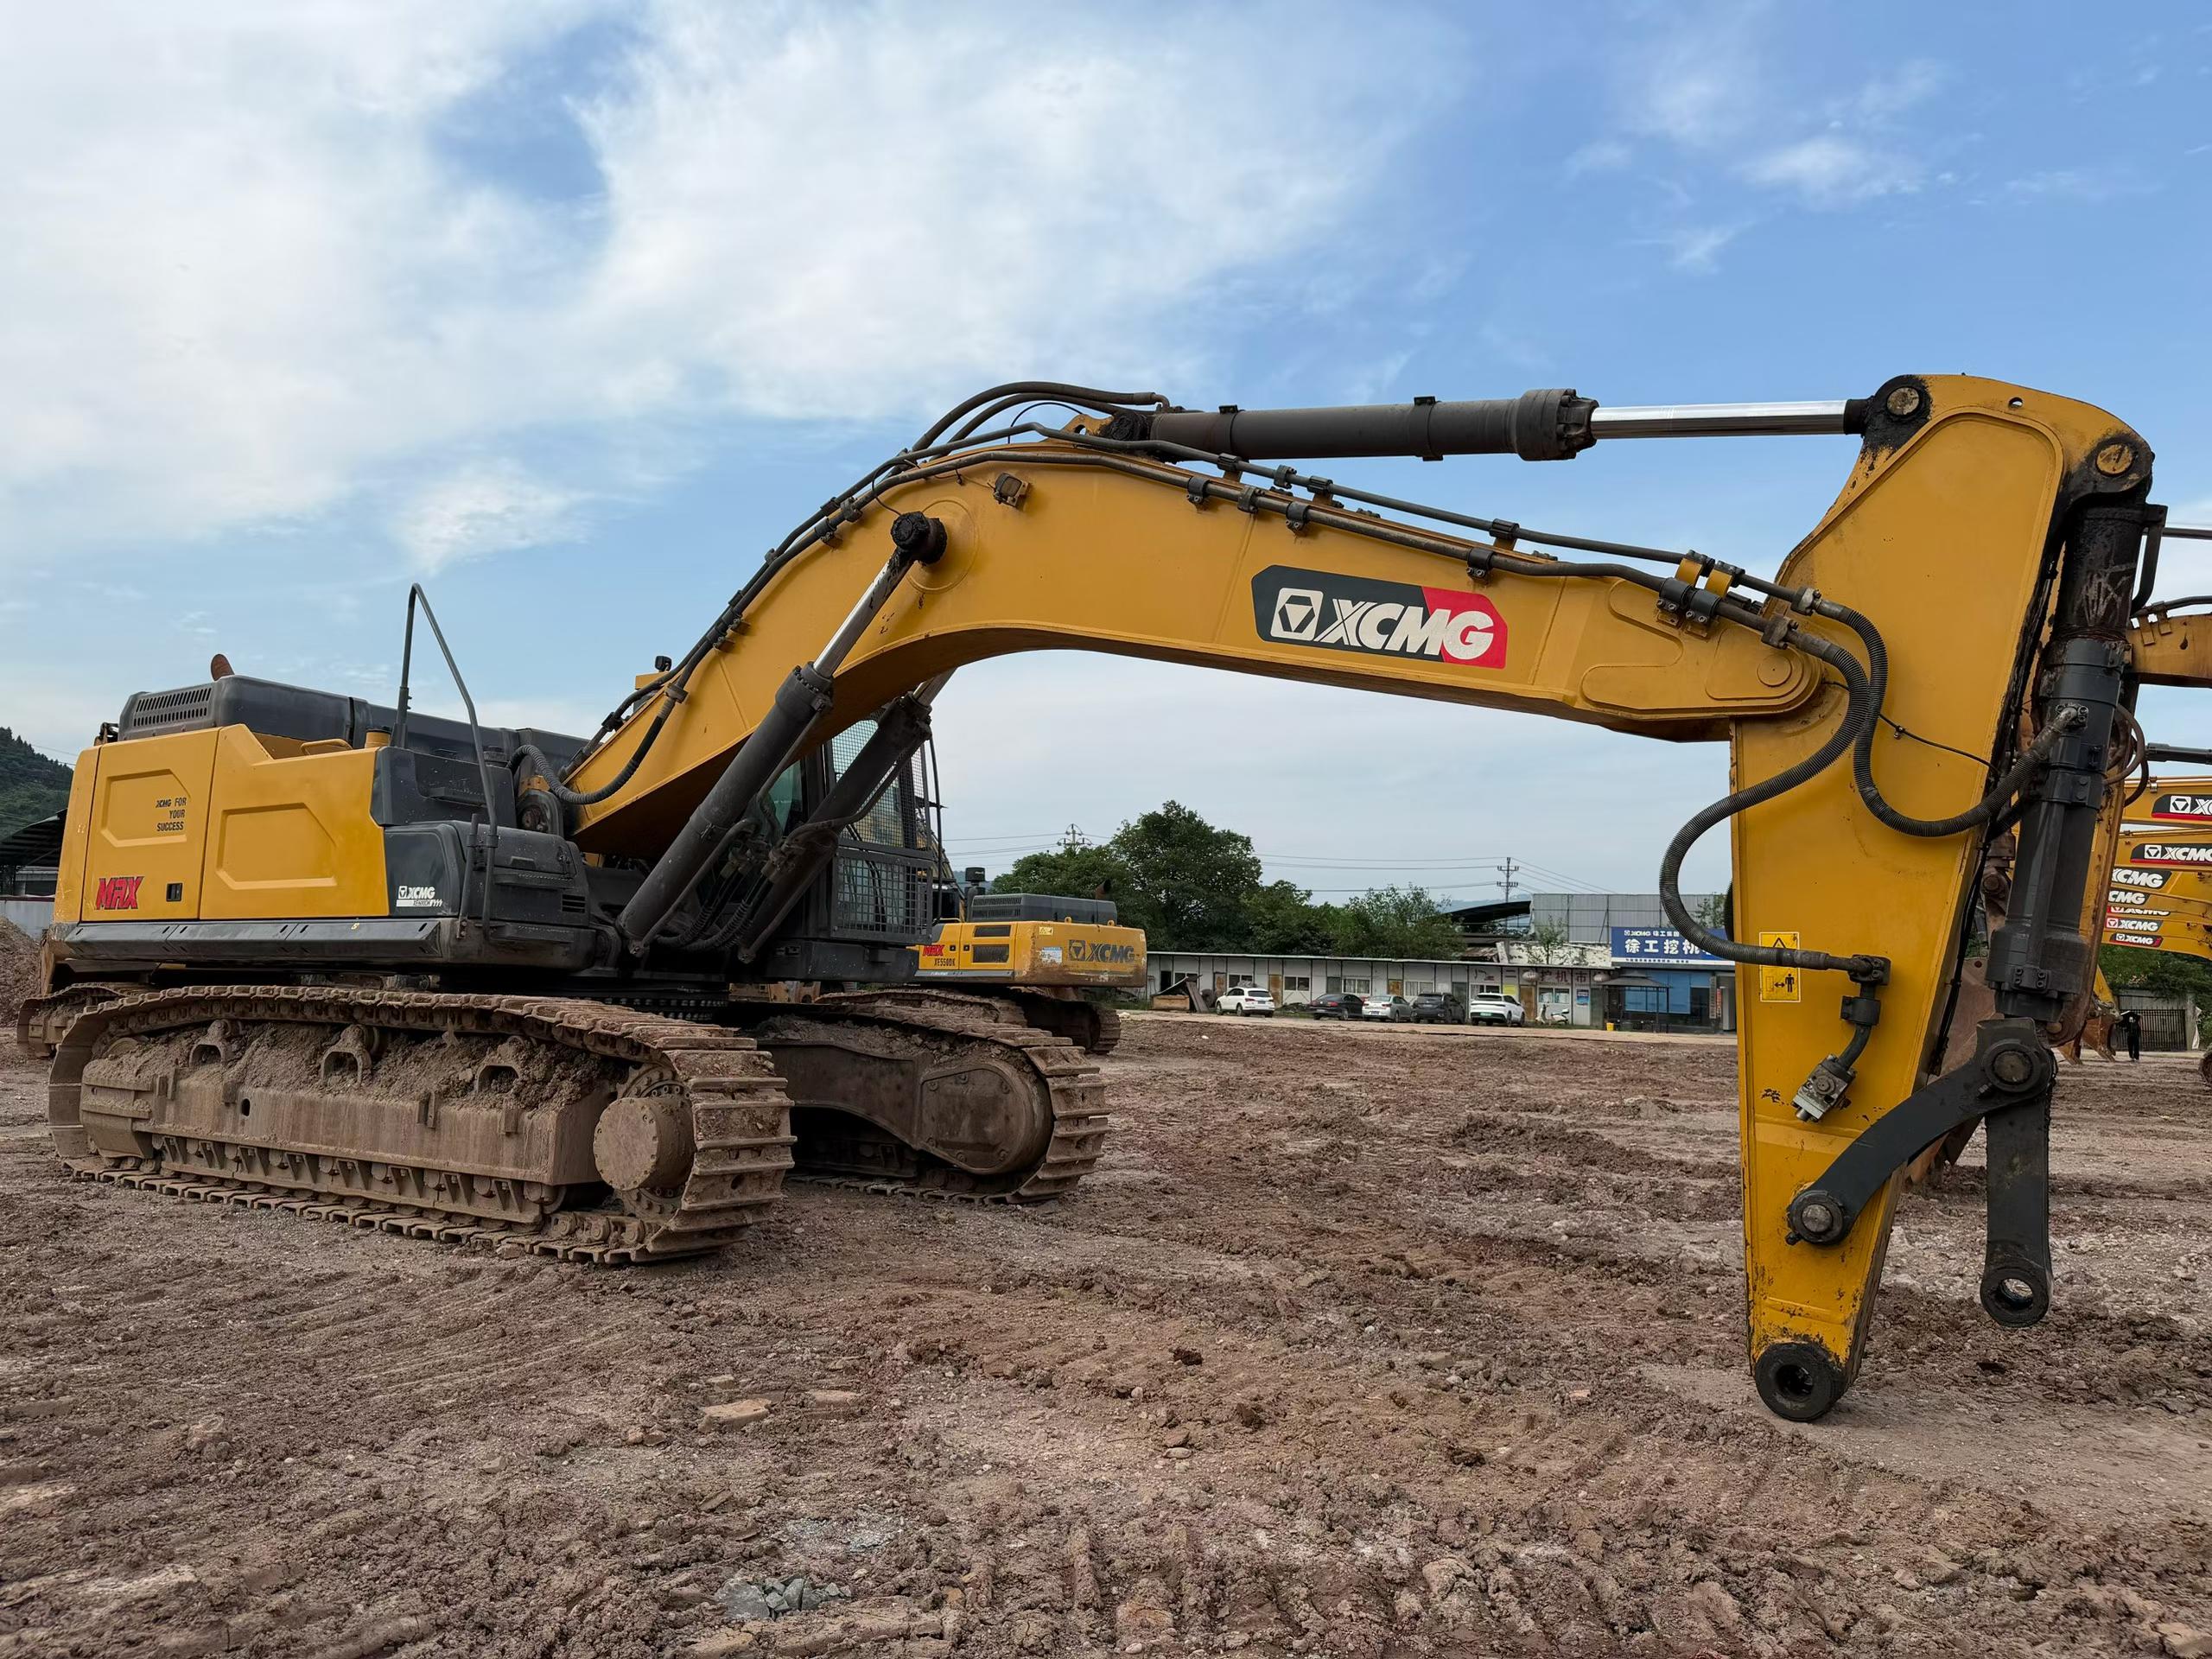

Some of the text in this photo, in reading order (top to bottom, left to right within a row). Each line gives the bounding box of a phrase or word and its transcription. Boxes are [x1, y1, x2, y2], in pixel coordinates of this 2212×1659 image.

[1313, 598, 1495, 661] XCMG
[156, 797, 188, 808] XCMG FOR
[2190, 798, 2212, 816] X
[169, 810, 186, 819] YOUR
[156, 821, 184, 832] SUCCESS
[96, 876, 144, 910] MAX
[407, 886, 435, 899] XCMG
[2108, 890, 2145, 905] CMG
[2118, 919, 2158, 931] XCMG
[2126, 934, 2154, 945] XCMG
[1085, 943, 1135, 963] XCMG
[1624, 938, 1711, 956] 徐工挖机
